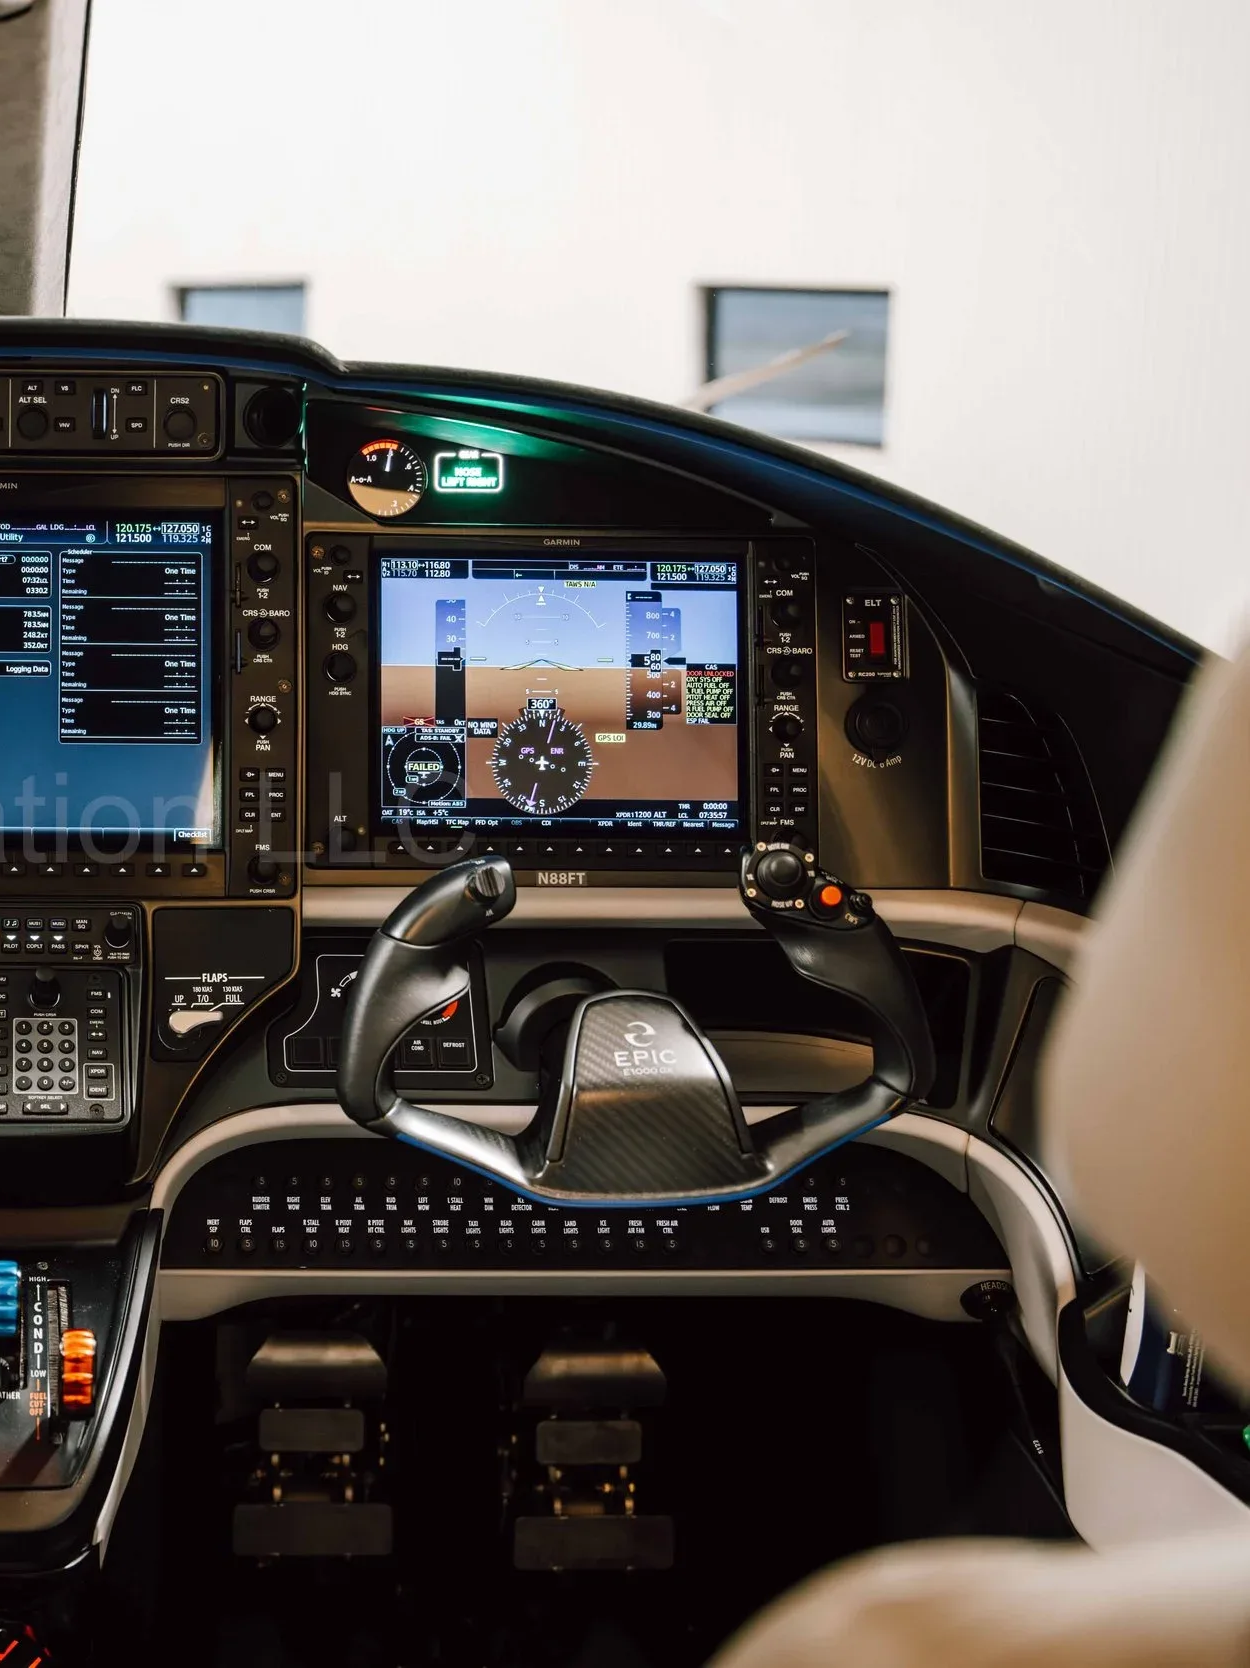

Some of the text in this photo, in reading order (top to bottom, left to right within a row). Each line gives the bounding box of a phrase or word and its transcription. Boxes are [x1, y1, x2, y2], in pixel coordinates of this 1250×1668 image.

[18, 396, 47, 404] ALT SEL
[170, 397, 190, 405] CRS2
[115, 523, 198, 533] 120.175 127.050
[0, 533, 23, 543] Utility
[115, 533, 198, 543] 121.500 119.325
[543, 538, 580, 549] GARMIN
[392, 561, 450, 569] 113.10 116.80
[656, 564, 725, 573] 120.175 127.050
[657, 573, 725, 581] 121.500 119.325
[864, 599, 882, 607] ELT
[6, 665, 48, 674] Logging Data
[851, 753, 902, 766] 12V Amp
[408, 763, 440, 771] FAILED
[699, 811, 727, 819] 07:35:57
[178, 831, 208, 839] Checklist
[537, 872, 586, 885] N88FT
[201, 973, 228, 983] FLAPS
[174, 994, 184, 1003] UP
[197, 994, 209, 1003] T/O
[225, 994, 241, 1003] FULL
[614, 1049, 677, 1067] EPIC
[30, 1370, 46, 1378] LOW
[30, 1392, 47, 1400] FUEL
[29, 1408, 43, 1416] OFF
